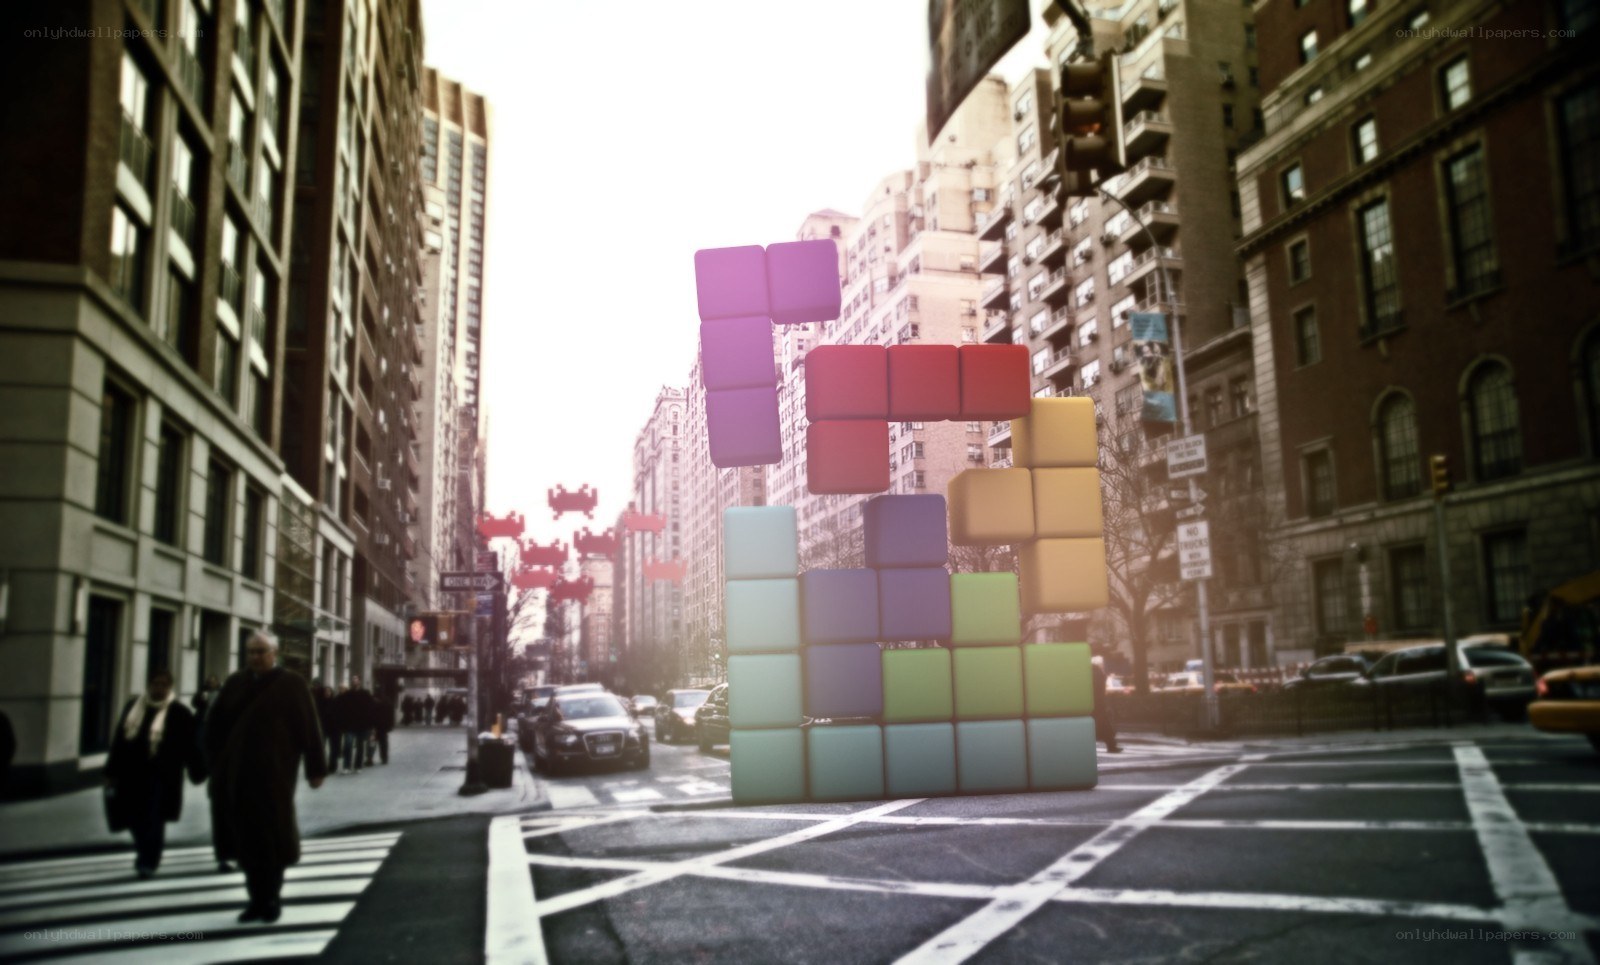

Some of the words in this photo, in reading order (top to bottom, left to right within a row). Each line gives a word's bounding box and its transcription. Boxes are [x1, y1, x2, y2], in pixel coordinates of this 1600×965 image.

[1186, 526, 1199, 537] NO
[1179, 538, 1209, 551] TRUCKS
[449, 577, 467, 586] ONE
[475, 576, 493, 586] WAY
